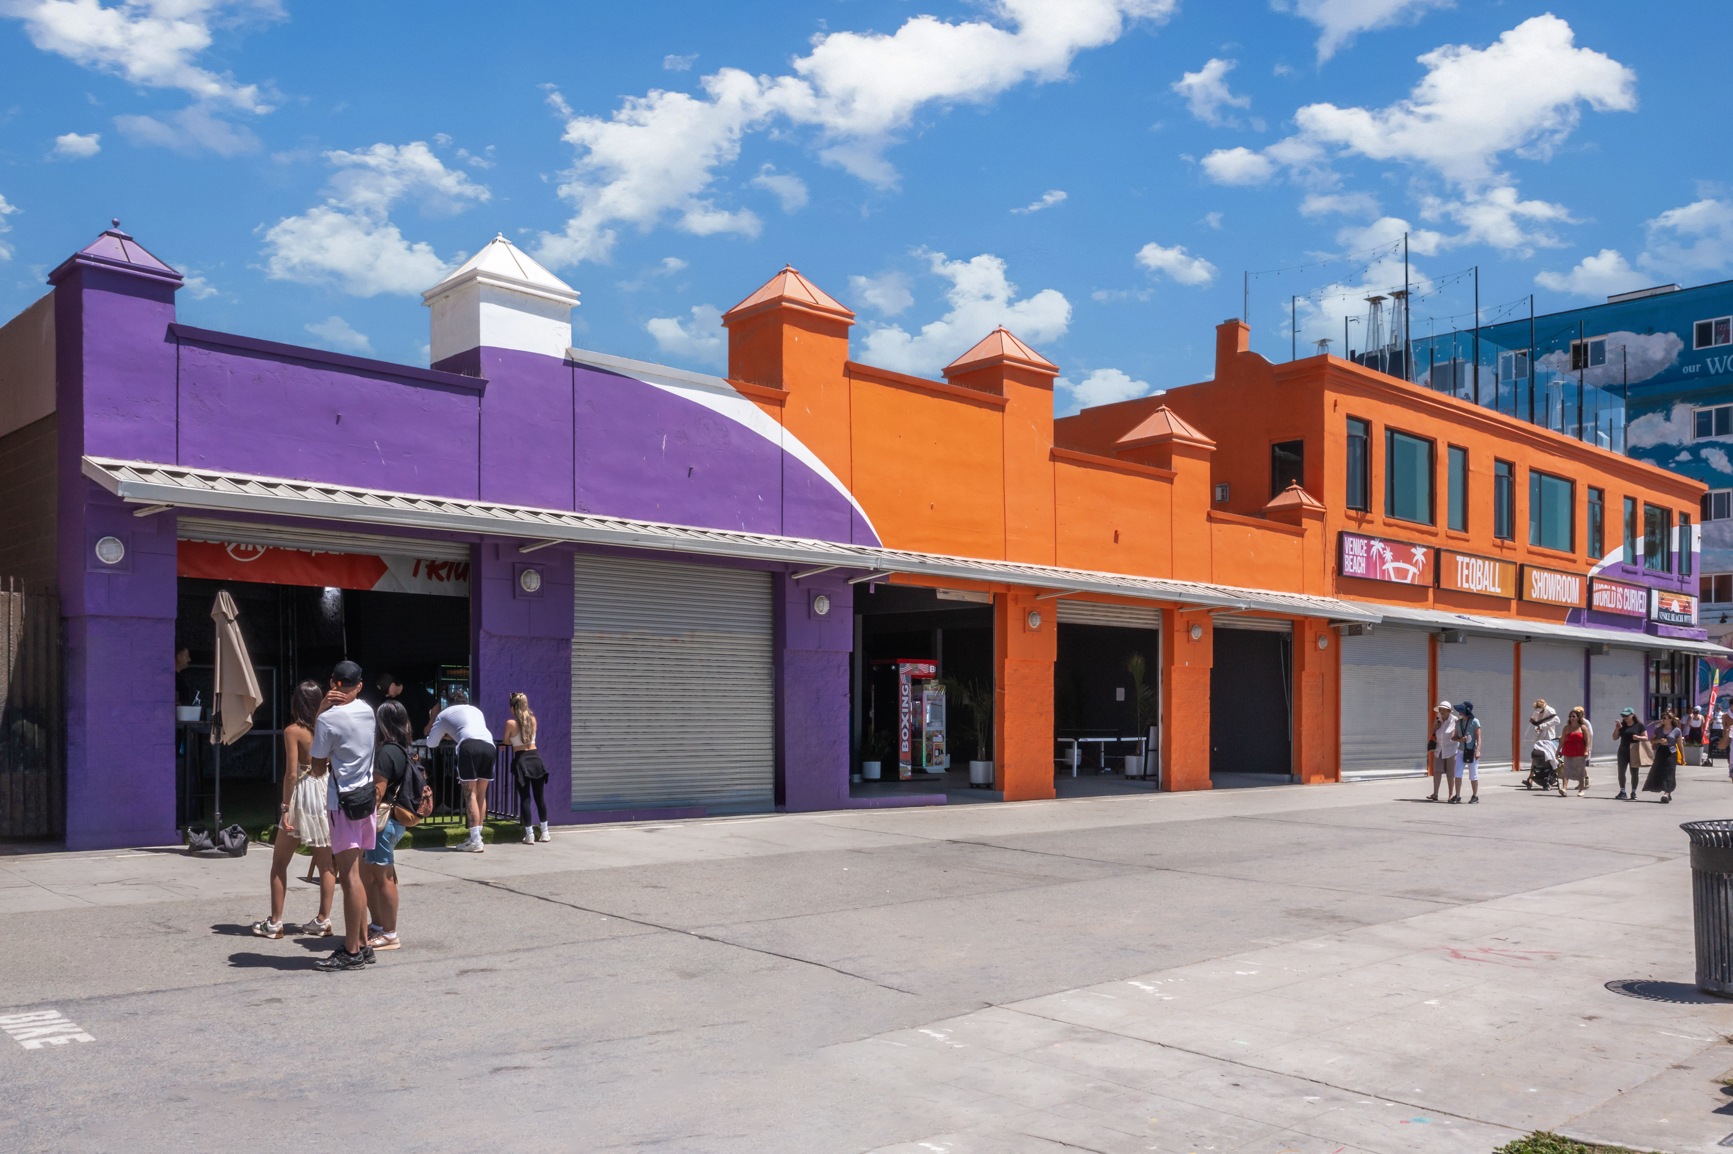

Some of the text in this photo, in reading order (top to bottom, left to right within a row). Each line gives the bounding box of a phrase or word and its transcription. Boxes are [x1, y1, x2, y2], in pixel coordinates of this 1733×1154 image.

[1682, 364, 1701, 374] our
[1344, 536, 1367, 557] VENICE
[1344, 554, 1366, 574] BEACH
[1456, 555, 1501, 593] TEQBALL
[1531, 569, 1580, 604] SHOWROOM
[1593, 582, 1646, 613] WORLD IS CURVED
[0, 1009, 97, 1050] BIKE
